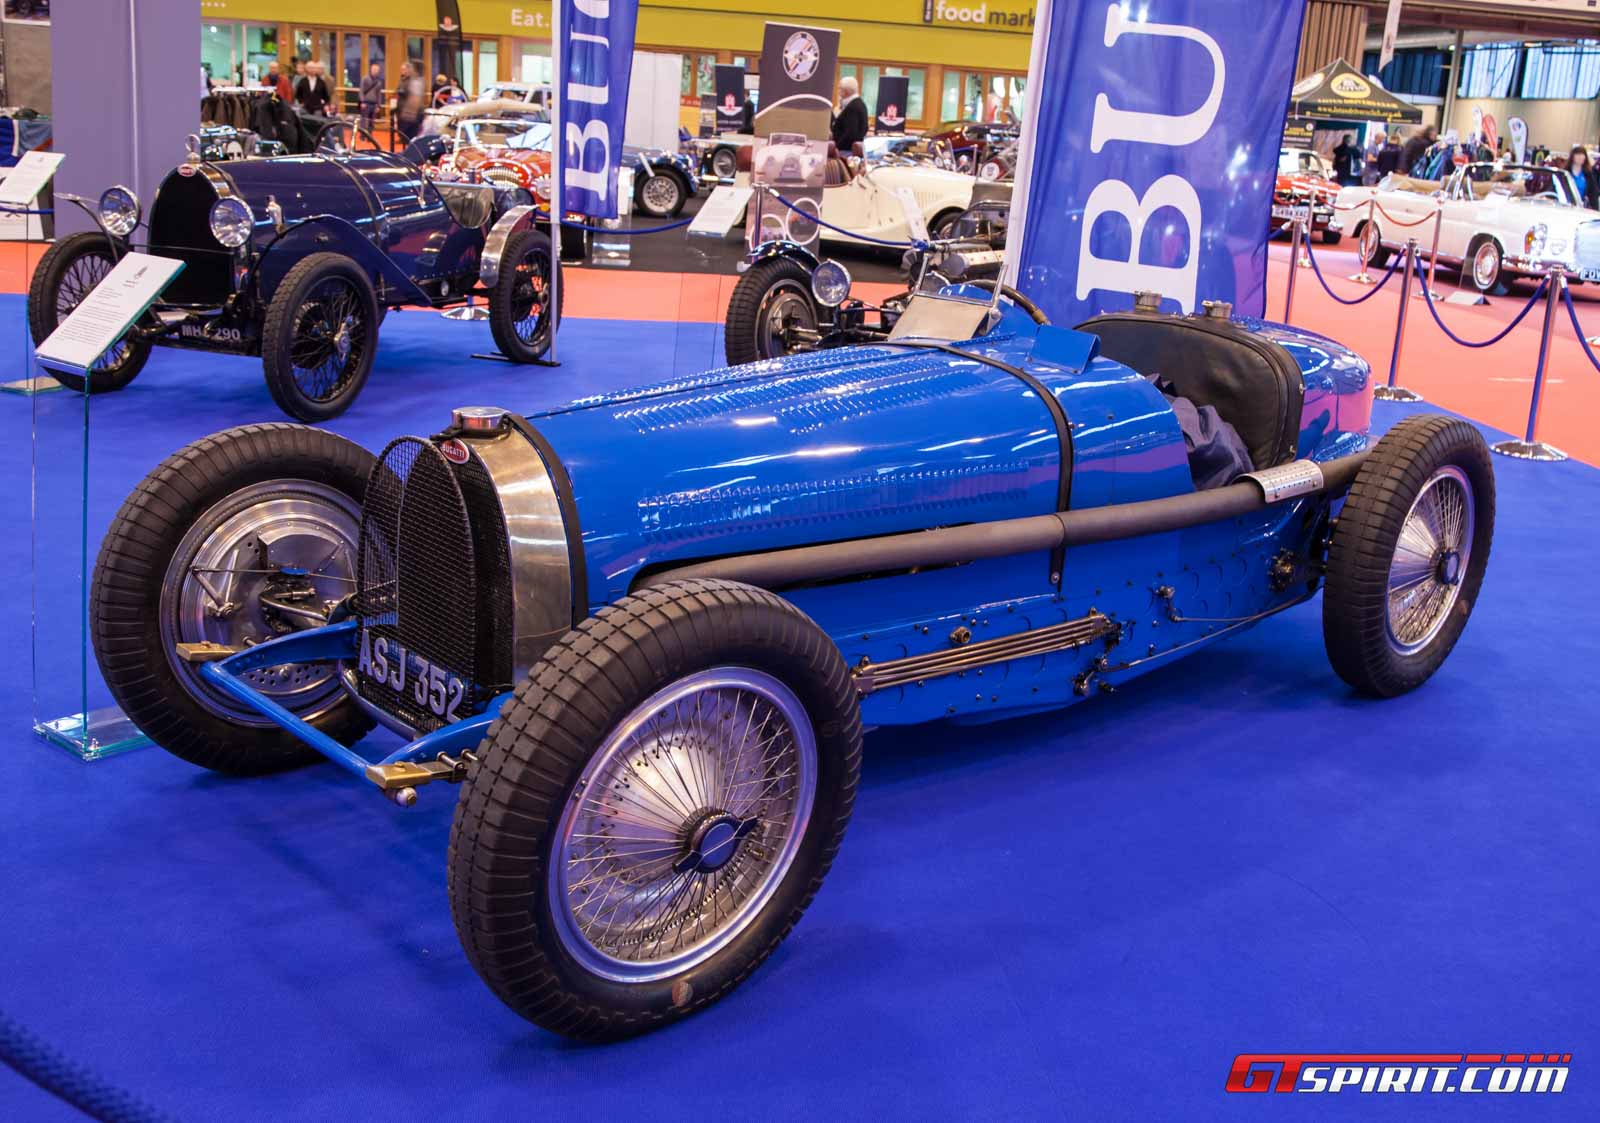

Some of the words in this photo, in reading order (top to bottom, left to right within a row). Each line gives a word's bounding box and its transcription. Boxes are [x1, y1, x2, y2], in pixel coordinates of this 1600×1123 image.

[936, 0, 986, 23] food
[564, 0, 610, 201] BU
[1076, 3, 1226, 316] BU
[358, 628, 406, 692] ASJ
[414, 655, 464, 723] 352
